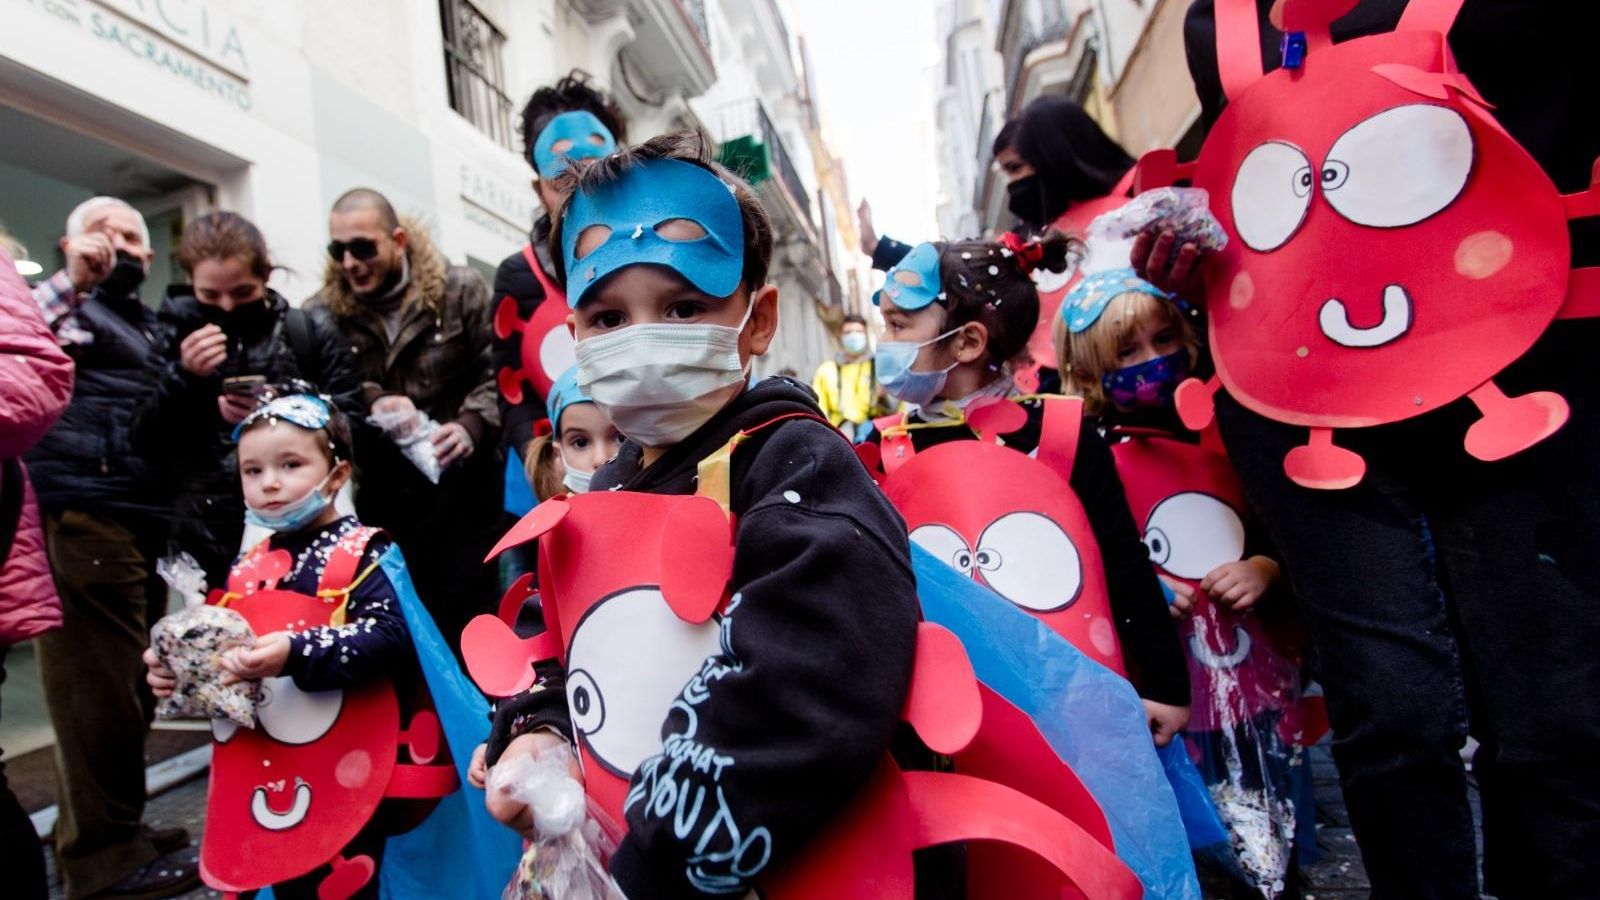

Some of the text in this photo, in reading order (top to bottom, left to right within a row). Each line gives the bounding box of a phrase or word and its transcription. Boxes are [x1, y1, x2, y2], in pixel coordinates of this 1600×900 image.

[90, 12, 253, 111] SACRAMENTO
[135, 0, 250, 71] CIA
[663, 738, 735, 782] WHAT
[687, 785, 772, 878] DO
